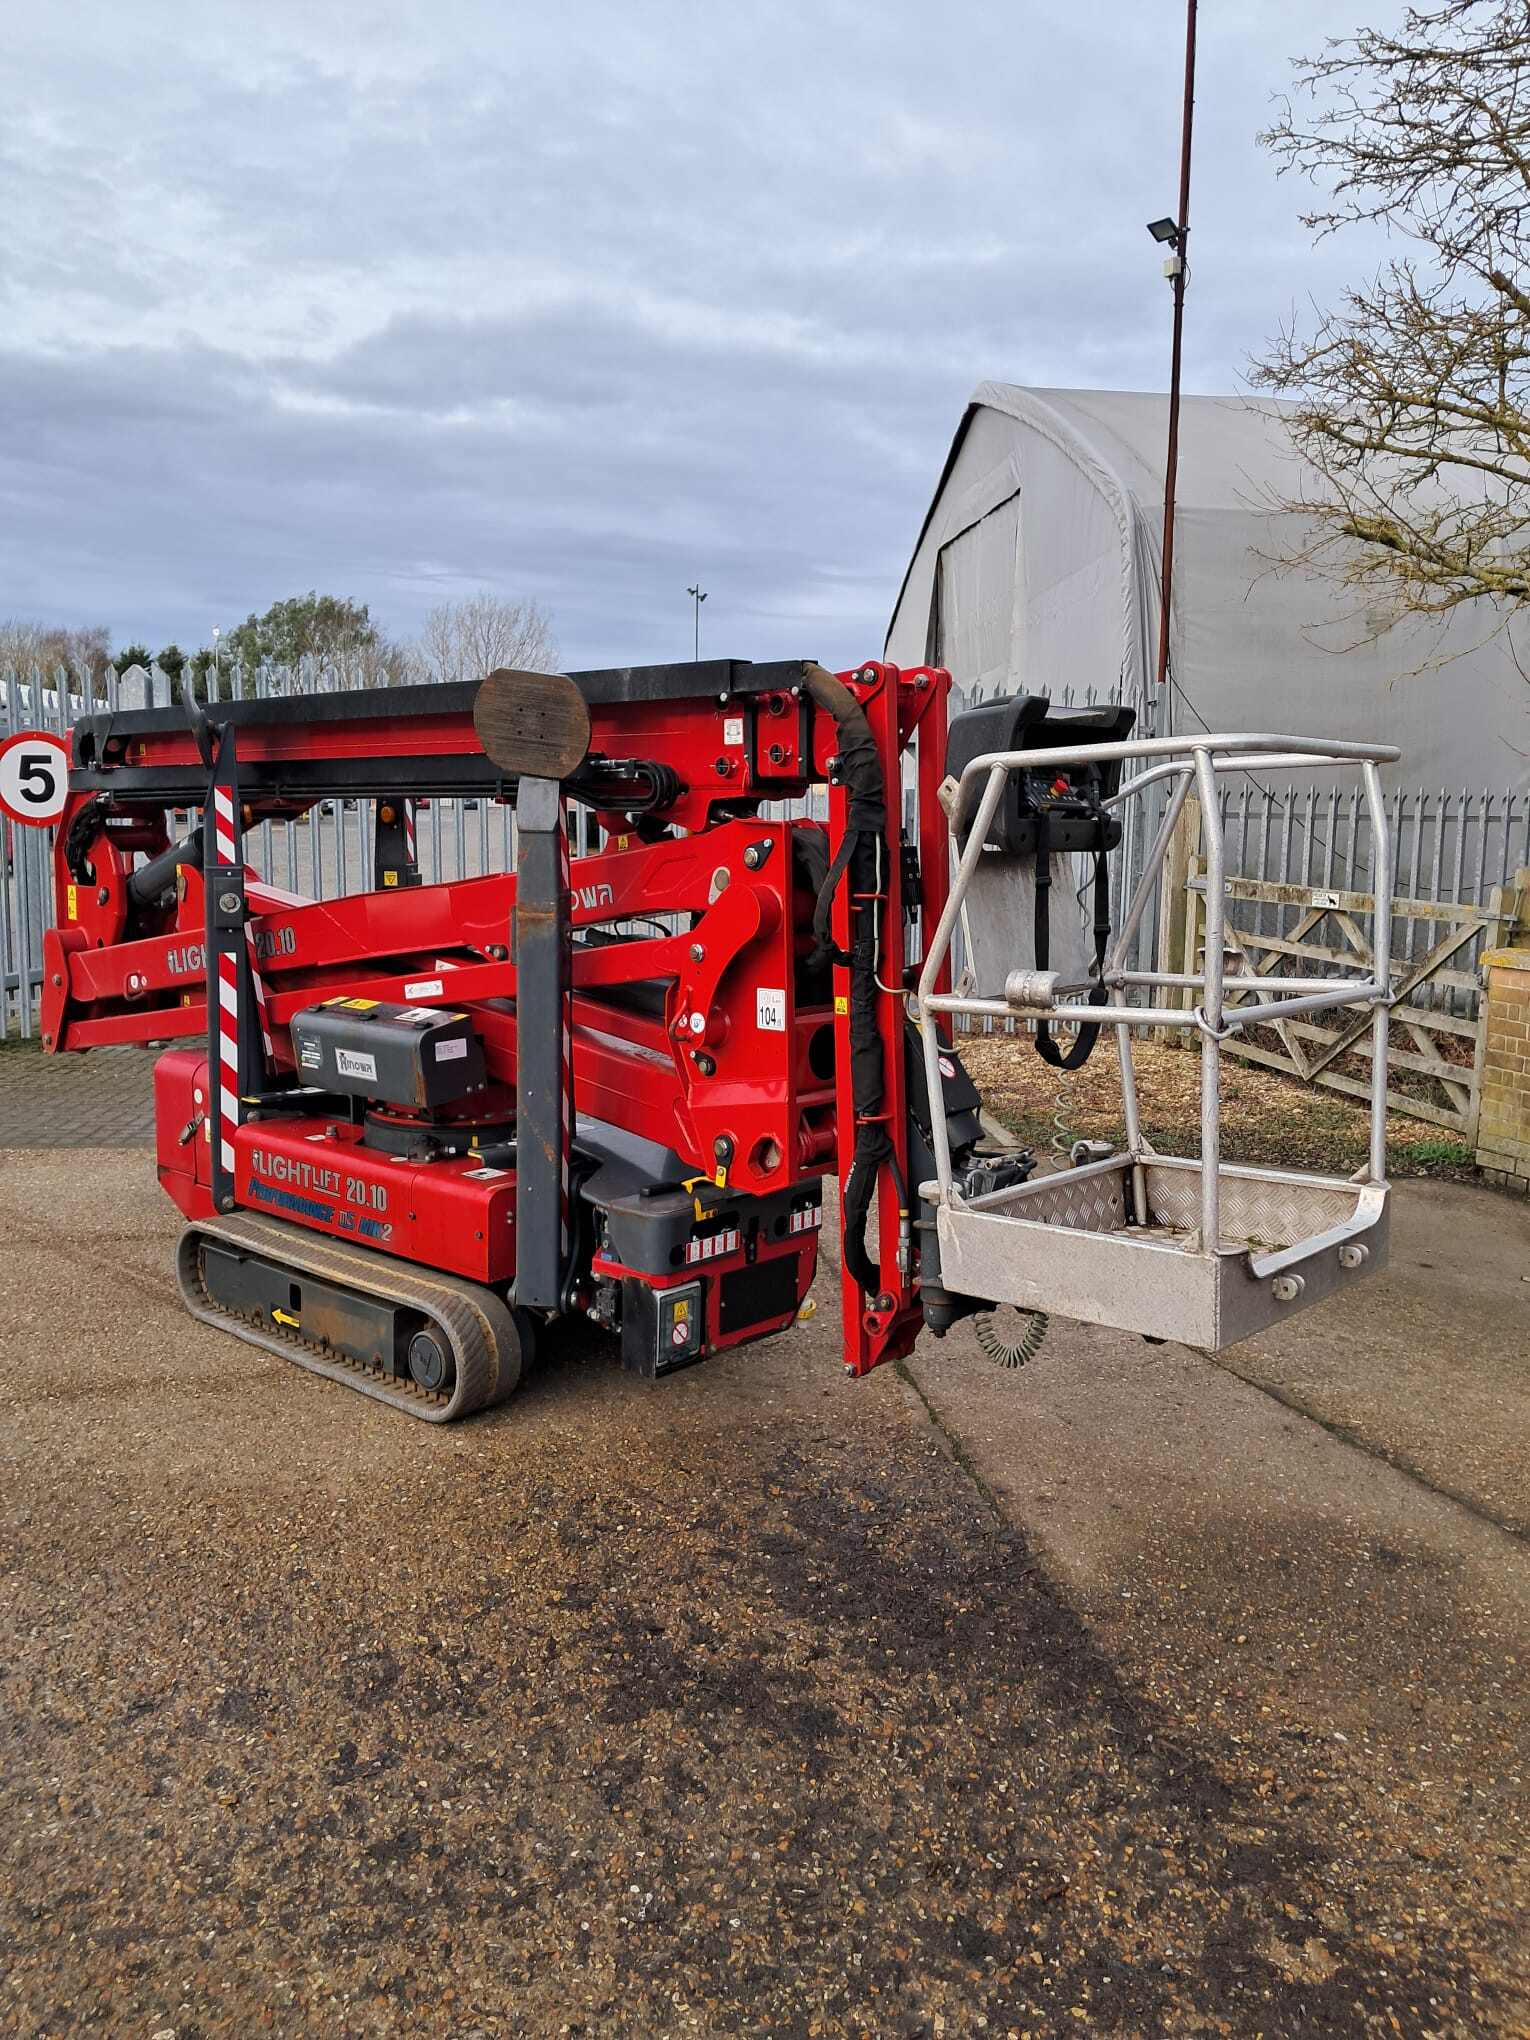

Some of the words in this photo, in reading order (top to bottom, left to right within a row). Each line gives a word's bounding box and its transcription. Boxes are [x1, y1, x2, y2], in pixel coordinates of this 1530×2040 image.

[19, 754, 56, 804] 5
[255, 926, 297, 958] 20.10
[760, 1006, 777, 1026] 104
[346, 1177, 388, 1212] 20.10
